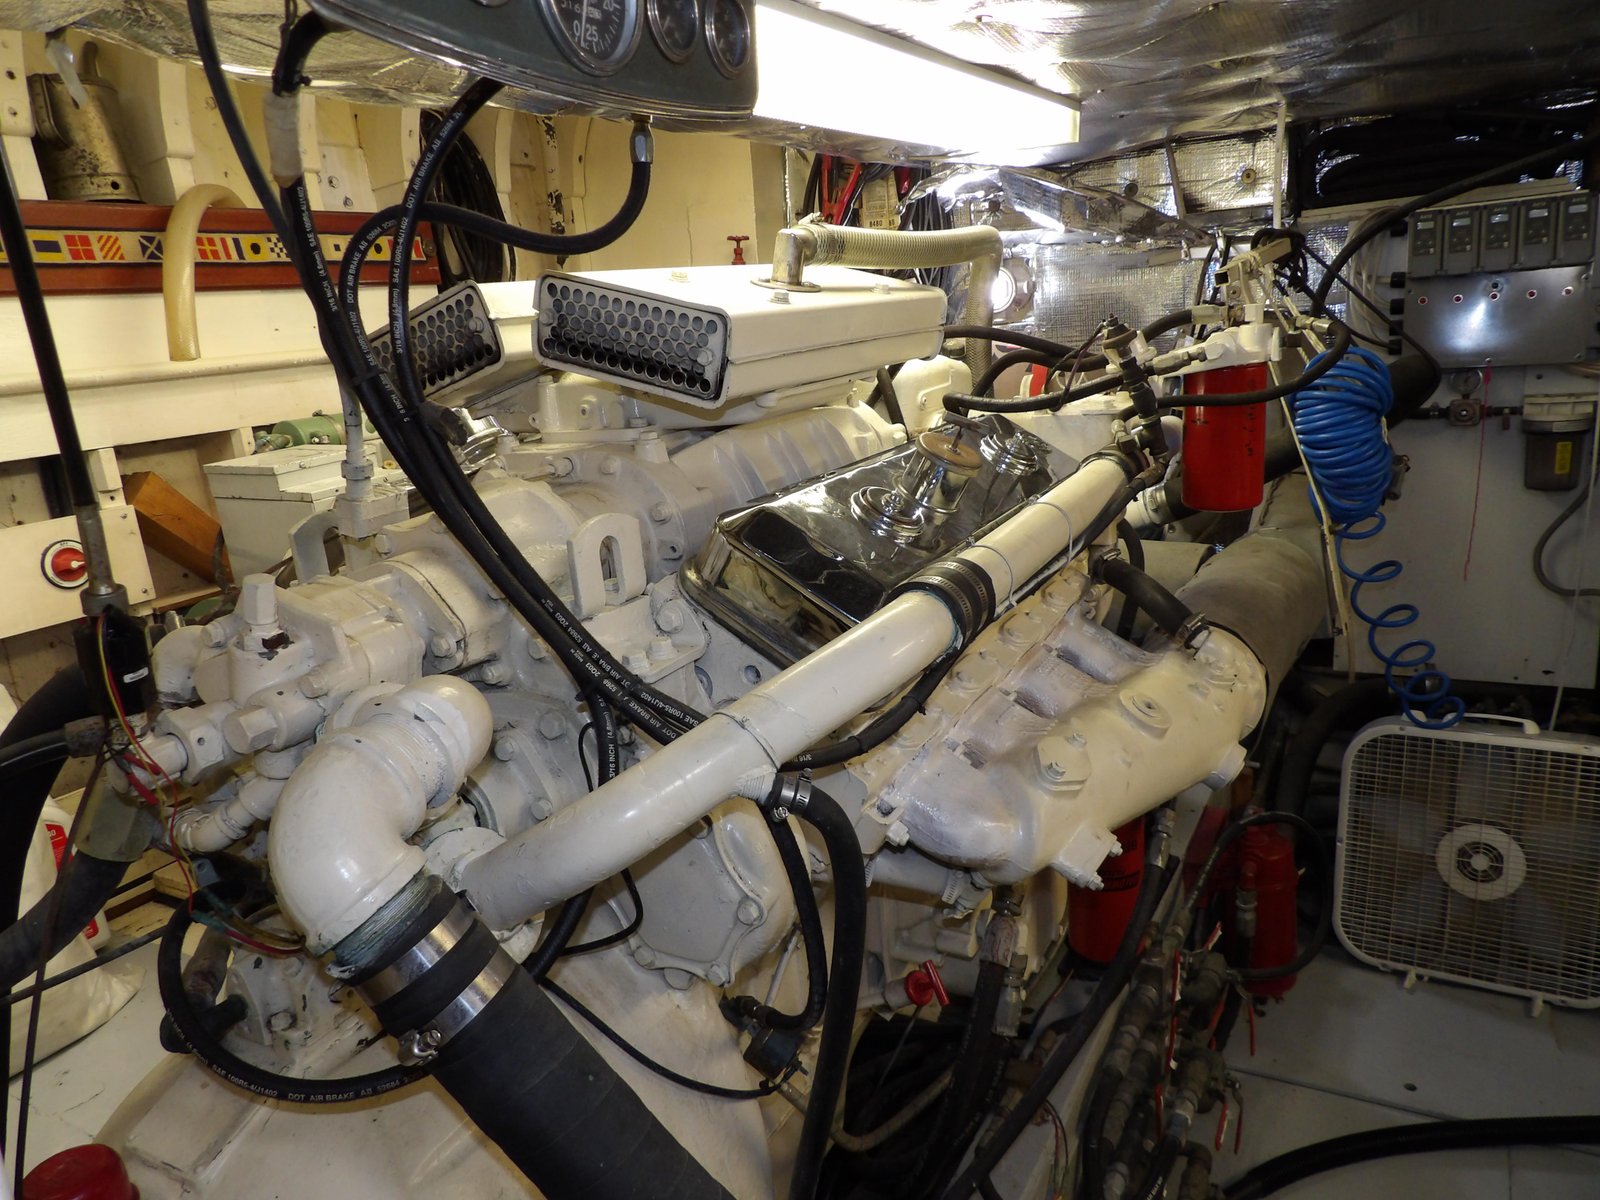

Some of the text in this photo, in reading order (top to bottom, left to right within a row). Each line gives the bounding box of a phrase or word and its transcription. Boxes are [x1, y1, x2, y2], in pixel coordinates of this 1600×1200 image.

[586, 24, 598, 42] 25
[406, 193, 416, 209] DOT
[412, 178, 421, 191] AIR
[418, 152, 434, 177] BRAKE
[307, 232, 316, 248] SAE
[349, 251, 362, 275] BRAKE
[347, 274, 355, 287] AIR
[392, 267, 400, 283] SAE
[322, 280, 333, 298] INCH
[366, 353, 377, 366] SAE
[554, 612, 569, 628] 2Q03
[567, 626, 583, 643] 52684
[585, 662, 601, 678] 2Q03
[609, 670, 622, 680] AIR
[628, 701, 652, 721] BRAKE
[649, 718, 662, 728] AIR
[684, 715, 700, 727] SAE
[661, 726, 677, 739] DOT
[608, 744, 616, 762] INCH
[609, 763, 617, 778] 3/16
[212, 1064, 227, 1078] SAE
[288, 1092, 305, 1102] DOT
[309, 1094, 325, 1102] AIR
[325, 1092, 355, 1102] BRAKE
